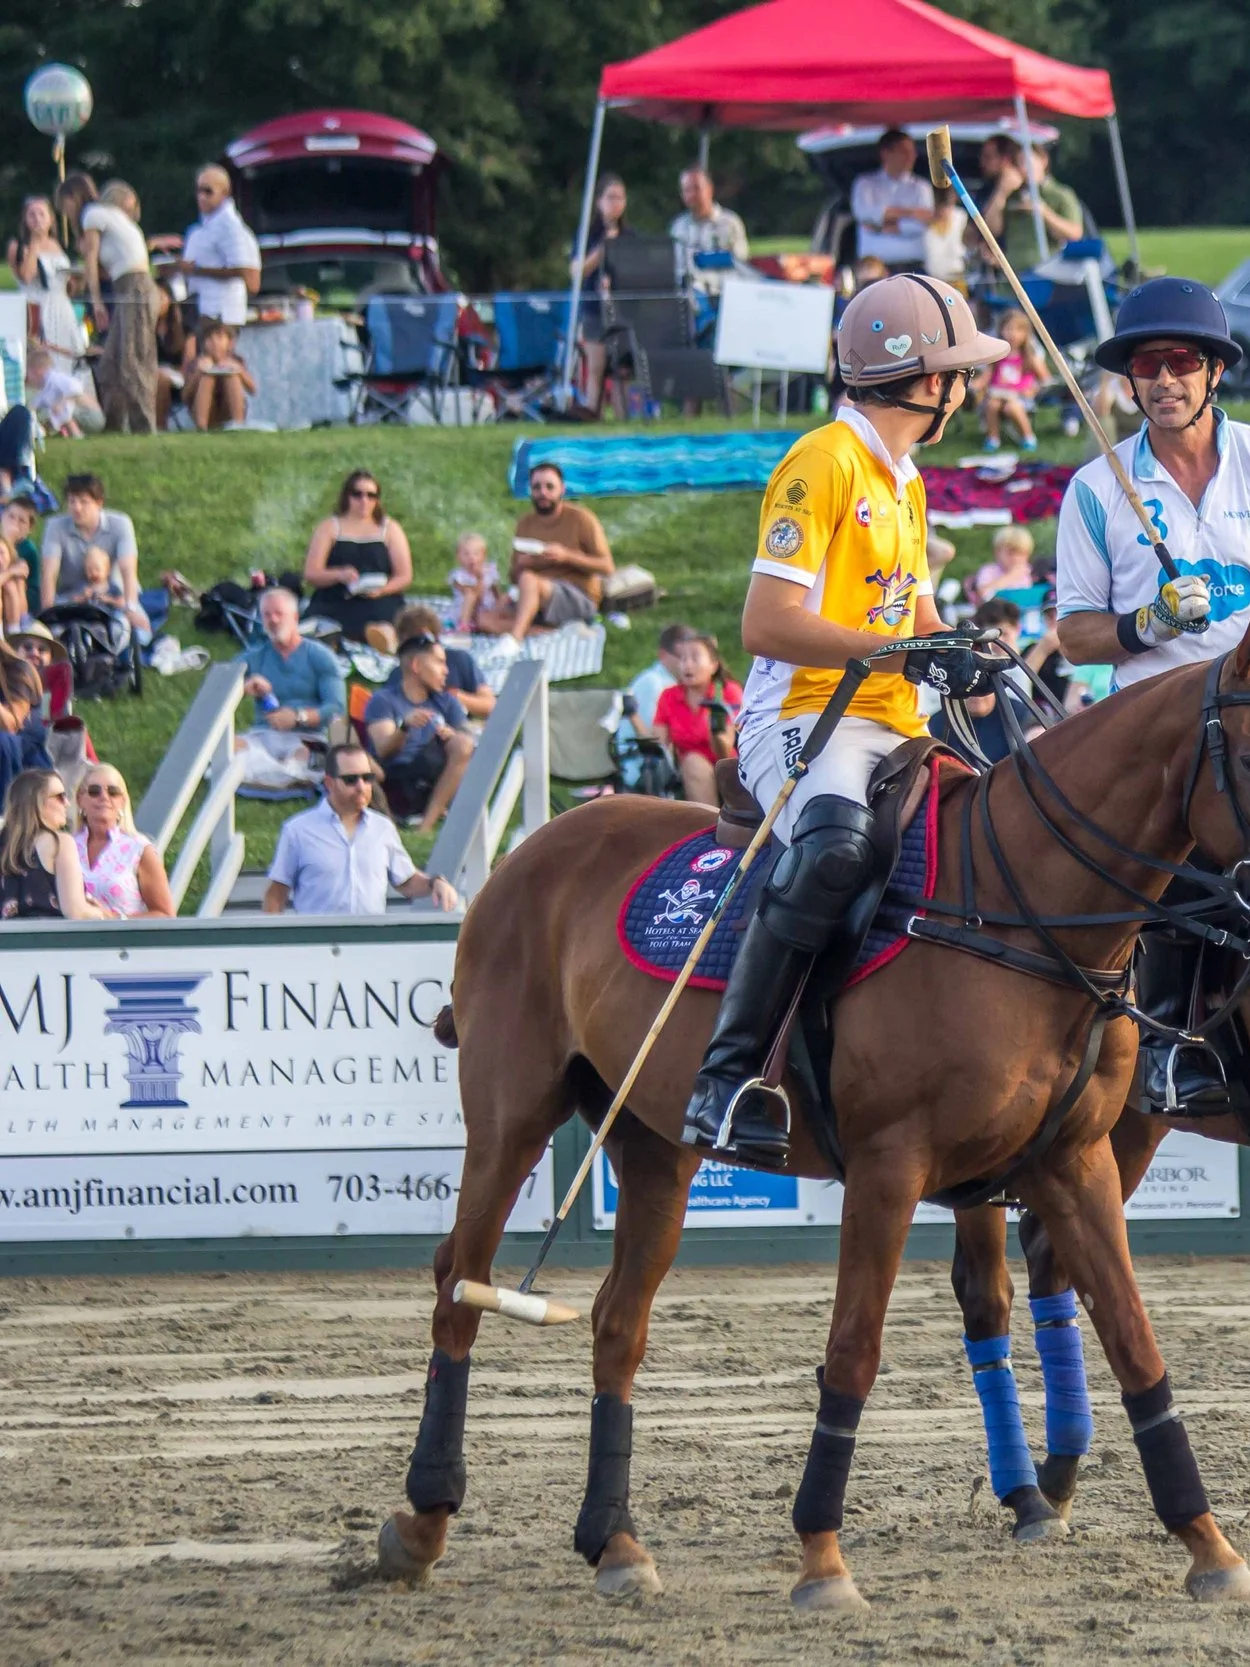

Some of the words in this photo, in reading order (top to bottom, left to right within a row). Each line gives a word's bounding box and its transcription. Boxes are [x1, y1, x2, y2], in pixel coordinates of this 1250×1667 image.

[1136, 498, 1169, 546] 3
[645, 926, 676, 935] HOTELS
[677, 927, 688, 935] AT
[671, 940, 692, 948] TEAM
[81, 1114, 295, 1133] MANAGEMENT
[314, 1112, 397, 1128] MADE
[709, 1174, 734, 1188] LLC
[1136, 1184, 1190, 1194] IVING
[733, 1196, 771, 1209] Agency
